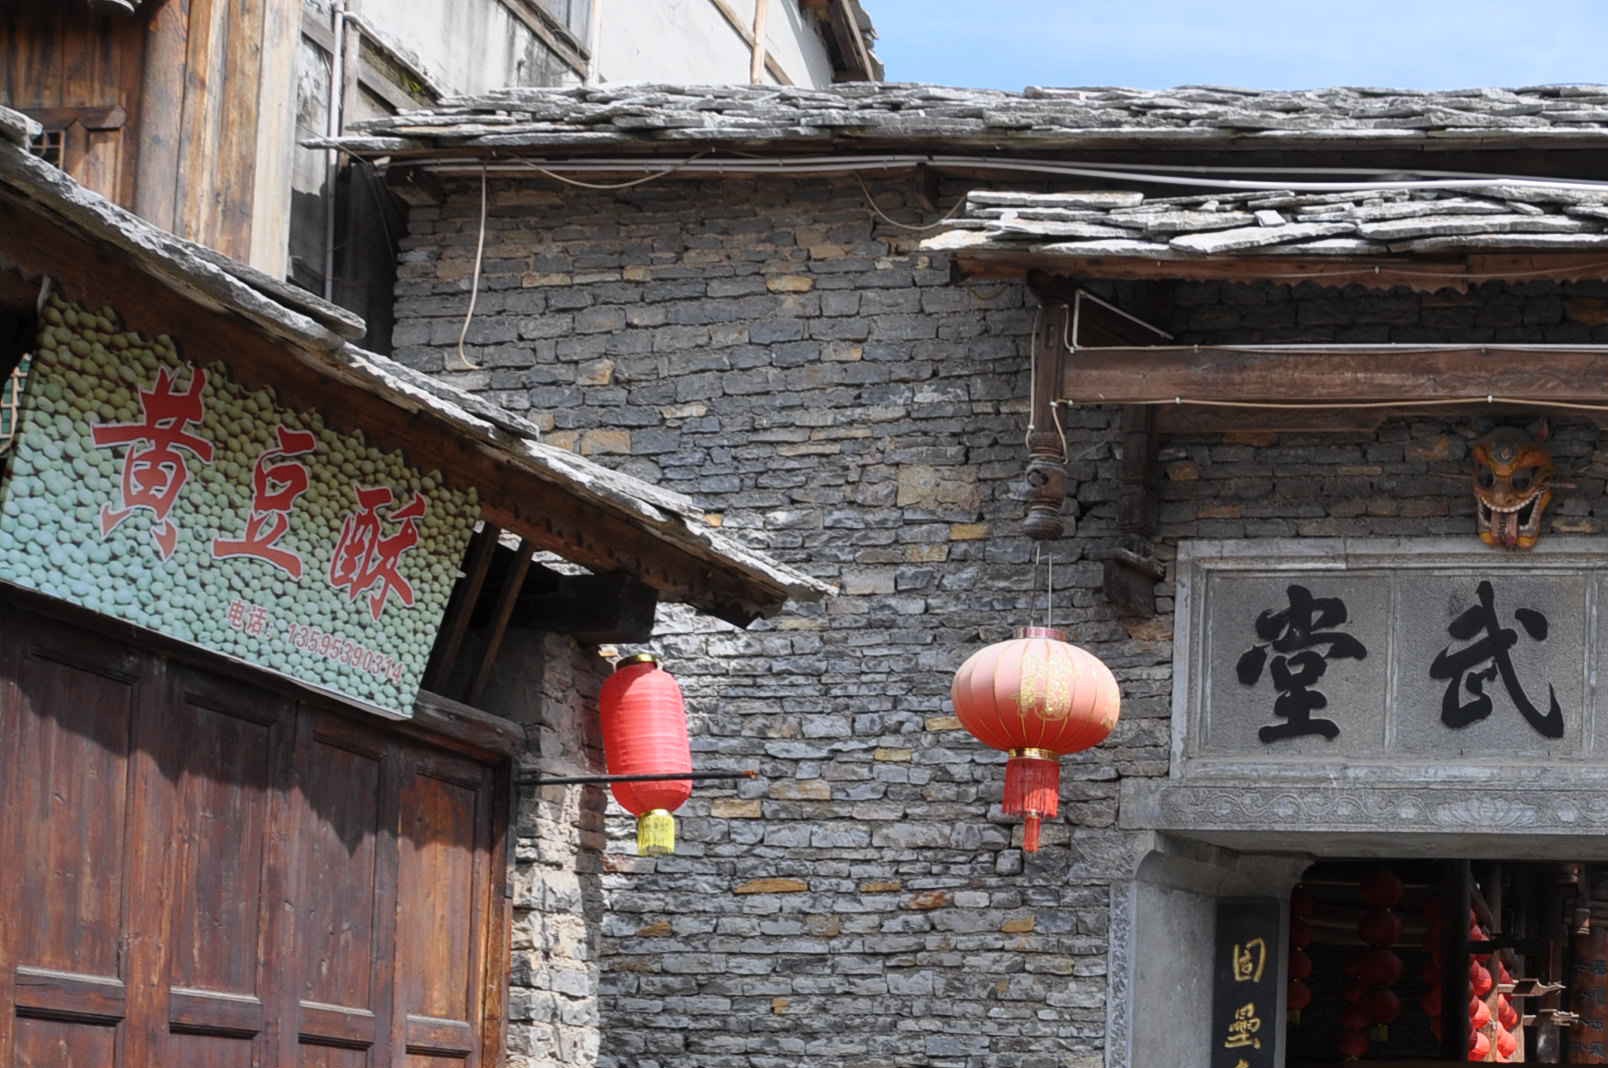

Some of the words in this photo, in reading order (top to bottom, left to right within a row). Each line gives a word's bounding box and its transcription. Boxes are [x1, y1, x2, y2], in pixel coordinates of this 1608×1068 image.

[90, 366, 427, 622] 黄豆酥
[287, 623, 402, 681] 13595390314
